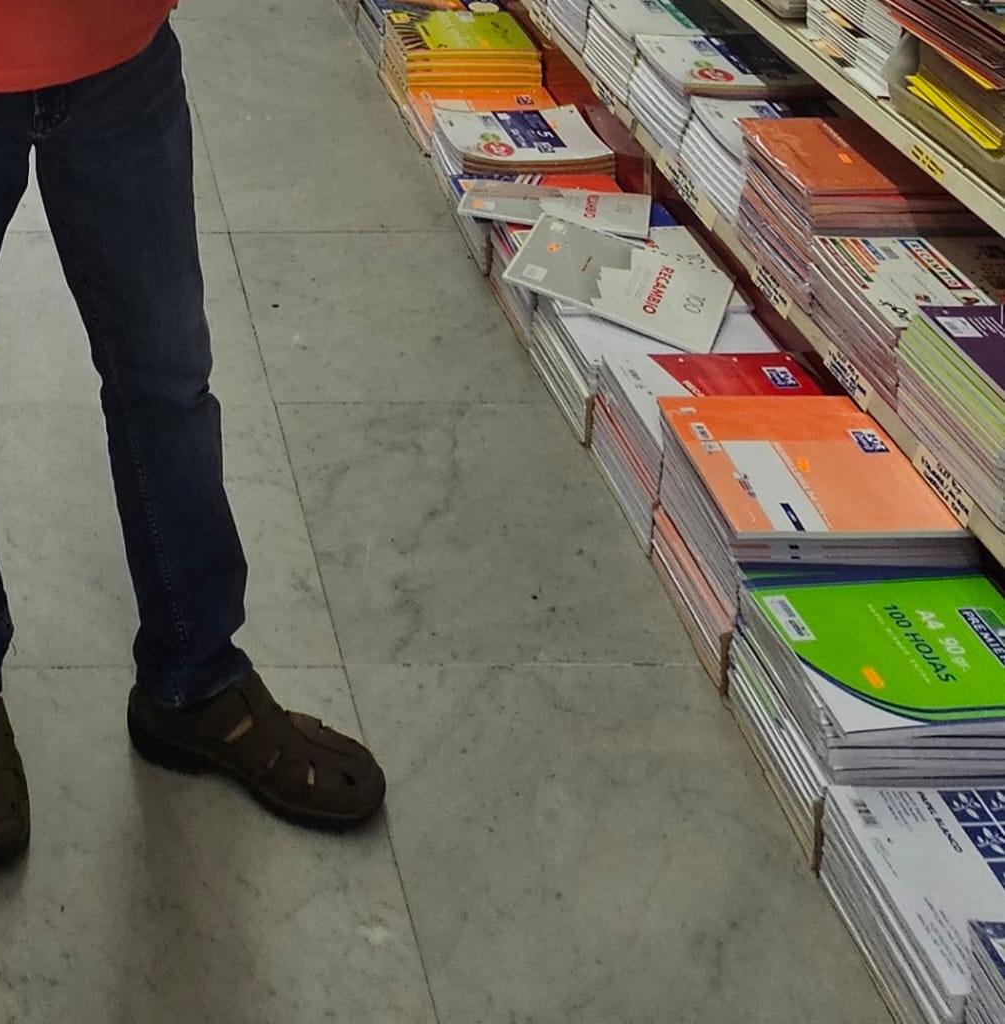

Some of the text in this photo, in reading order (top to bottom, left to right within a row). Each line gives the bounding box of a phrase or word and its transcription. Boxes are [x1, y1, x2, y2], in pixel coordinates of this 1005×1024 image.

[910, 242, 958, 287] RECAMBIO
[643, 265, 675, 314] RECAMBIO
[915, 608, 946, 630] A4
[883, 603, 957, 682] 100 HOJAS
[934, 816, 963, 853] BLANCO
